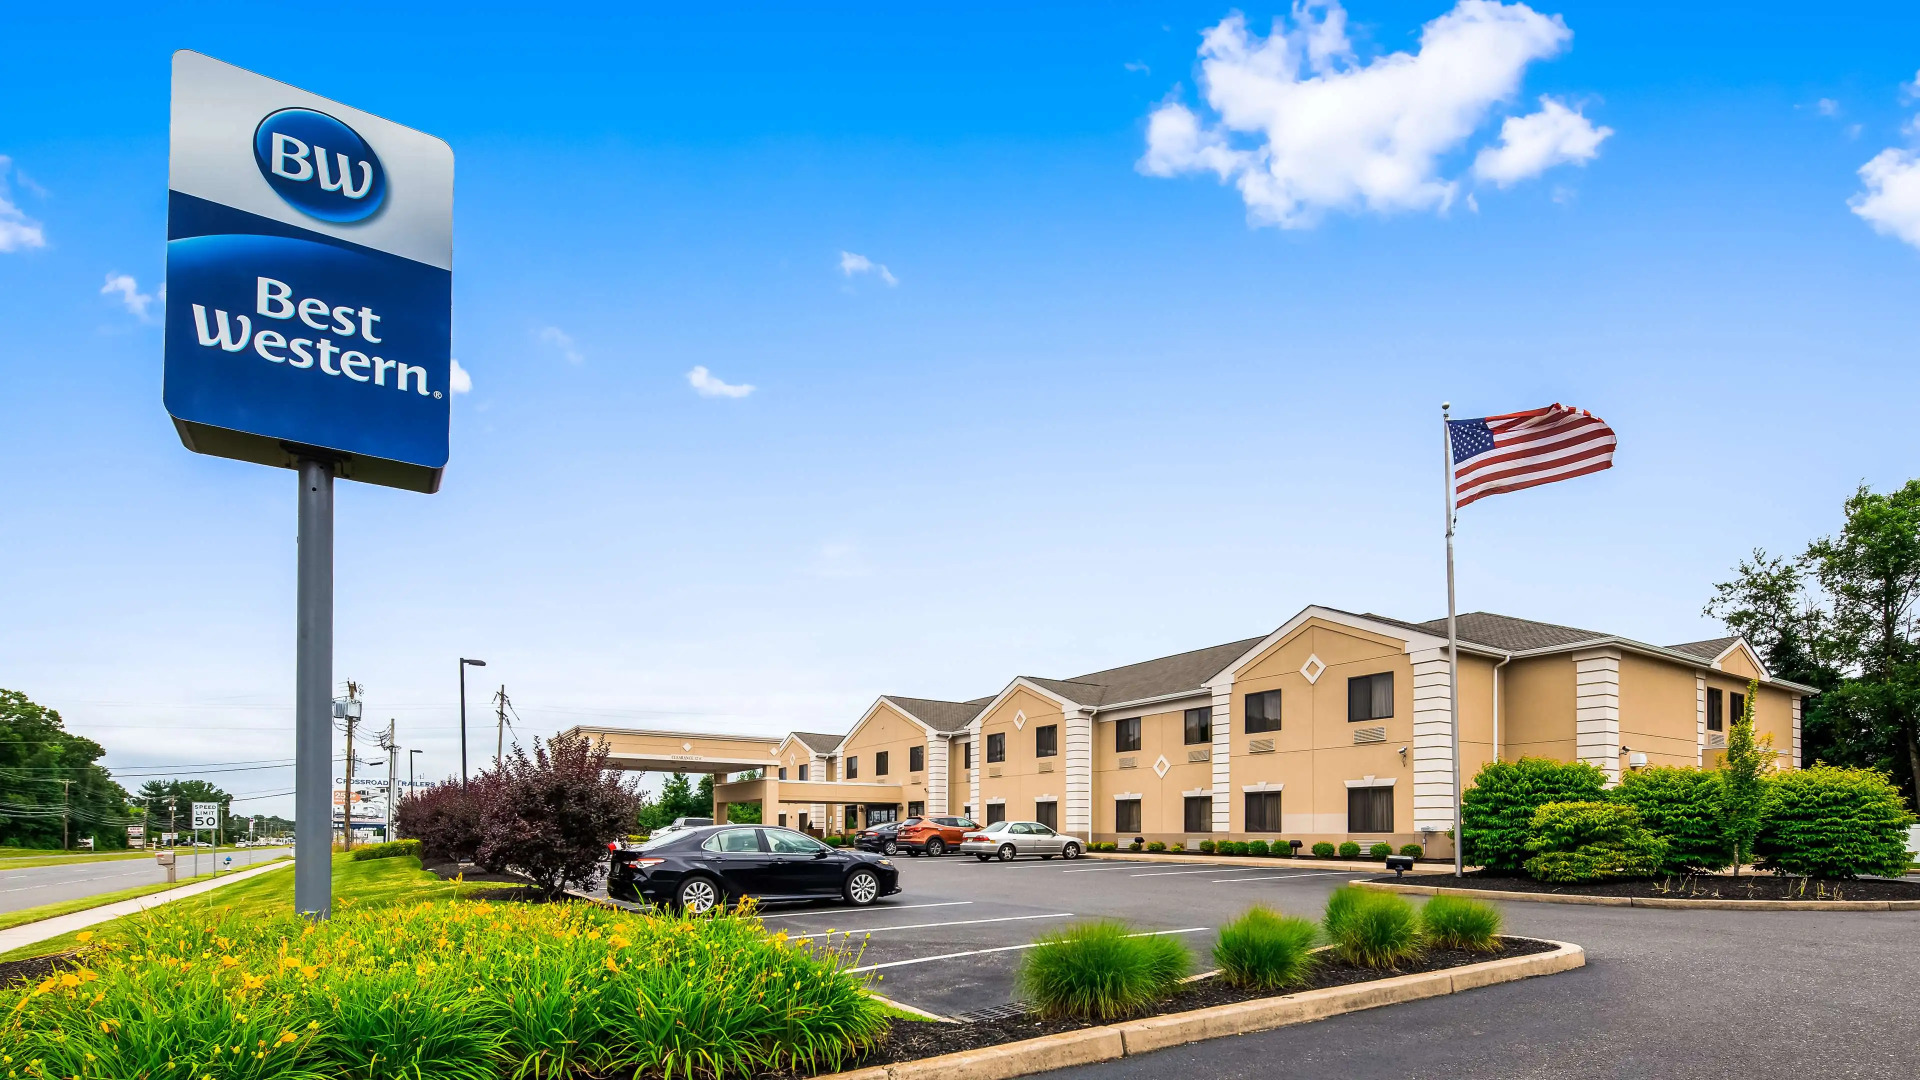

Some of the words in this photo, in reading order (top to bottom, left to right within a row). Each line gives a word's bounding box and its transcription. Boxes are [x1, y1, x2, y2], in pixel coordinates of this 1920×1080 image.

[271, 131, 373, 199] BW
[256, 276, 382, 344] Best
[191, 303, 431, 397] Western
[335, 777, 389, 786] CROSSROAD
[194, 816, 216, 826] 50
